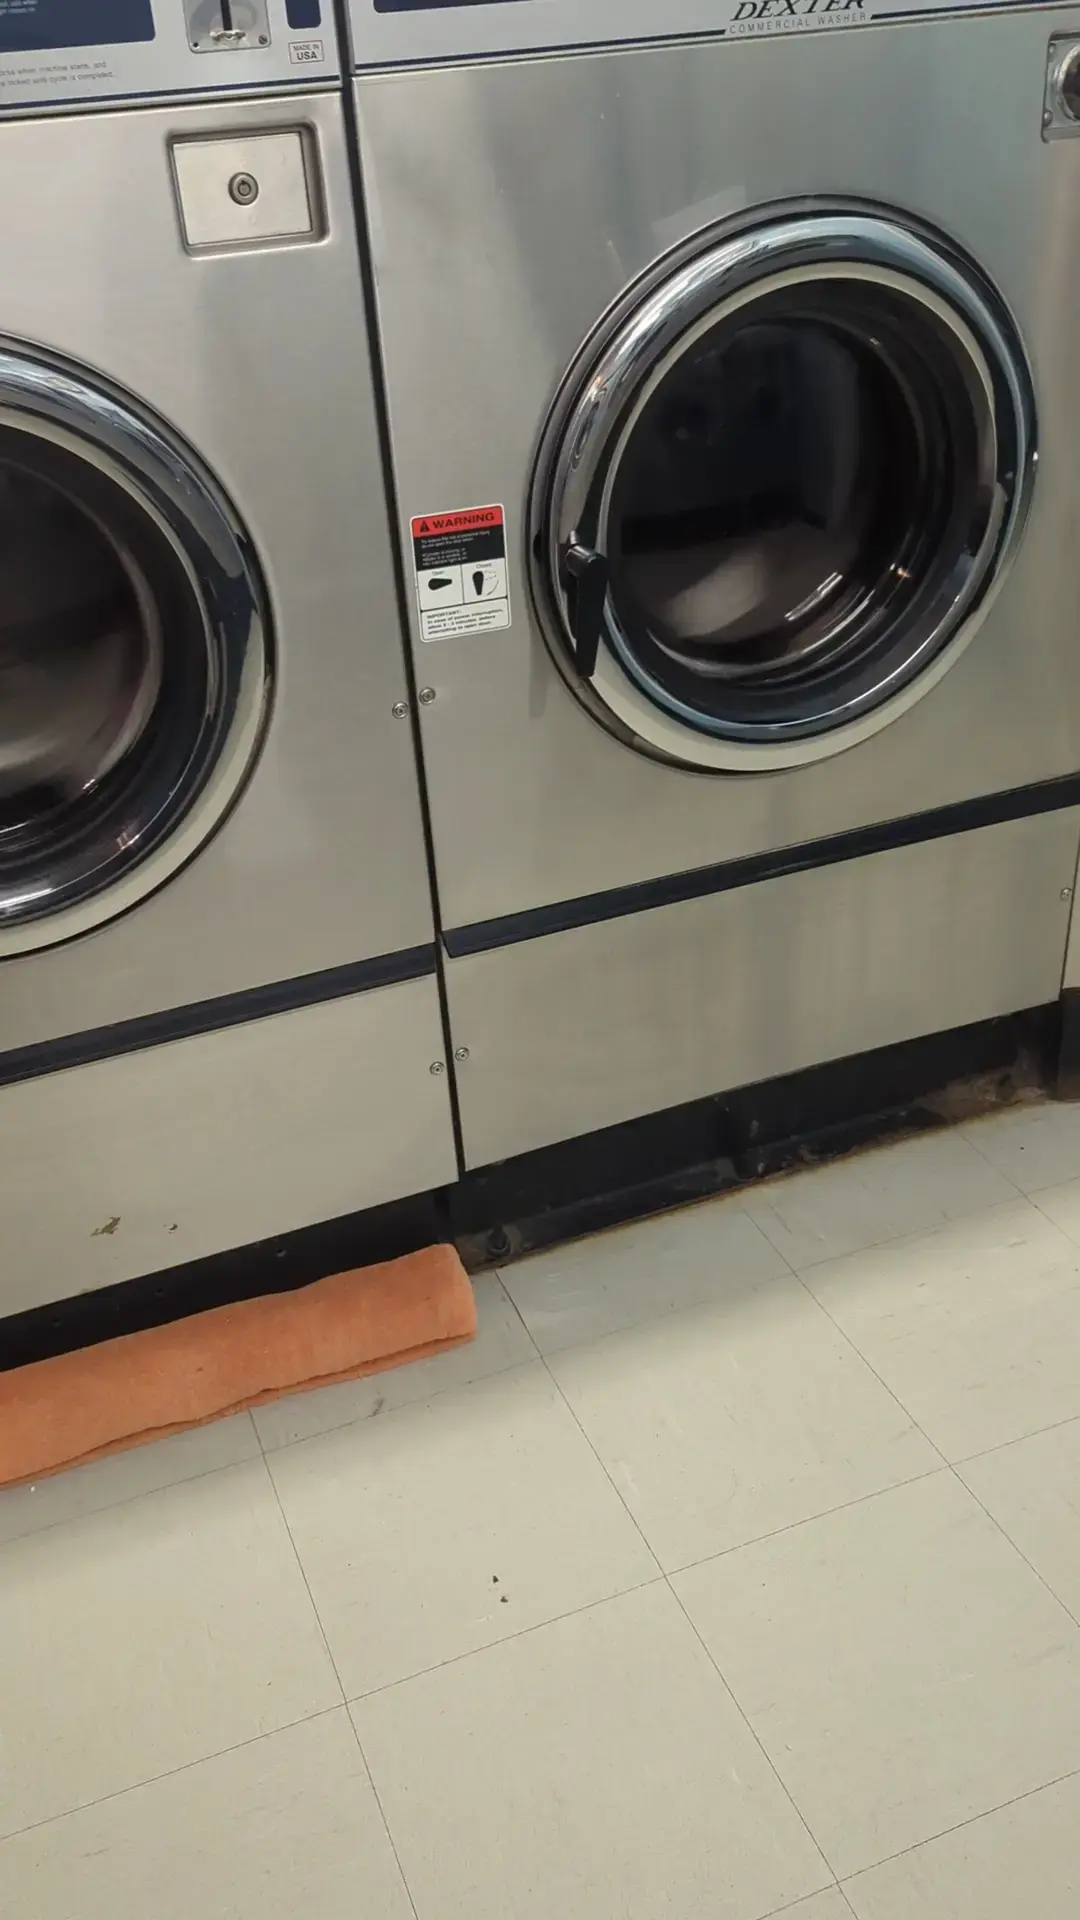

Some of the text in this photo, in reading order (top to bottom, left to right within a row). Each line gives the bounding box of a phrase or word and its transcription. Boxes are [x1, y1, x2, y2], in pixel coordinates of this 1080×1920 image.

[729, 12, 867, 34] COMMERCIAL WASHER
[296, 51, 318, 60] USA
[432, 512, 495, 529] WARNING
